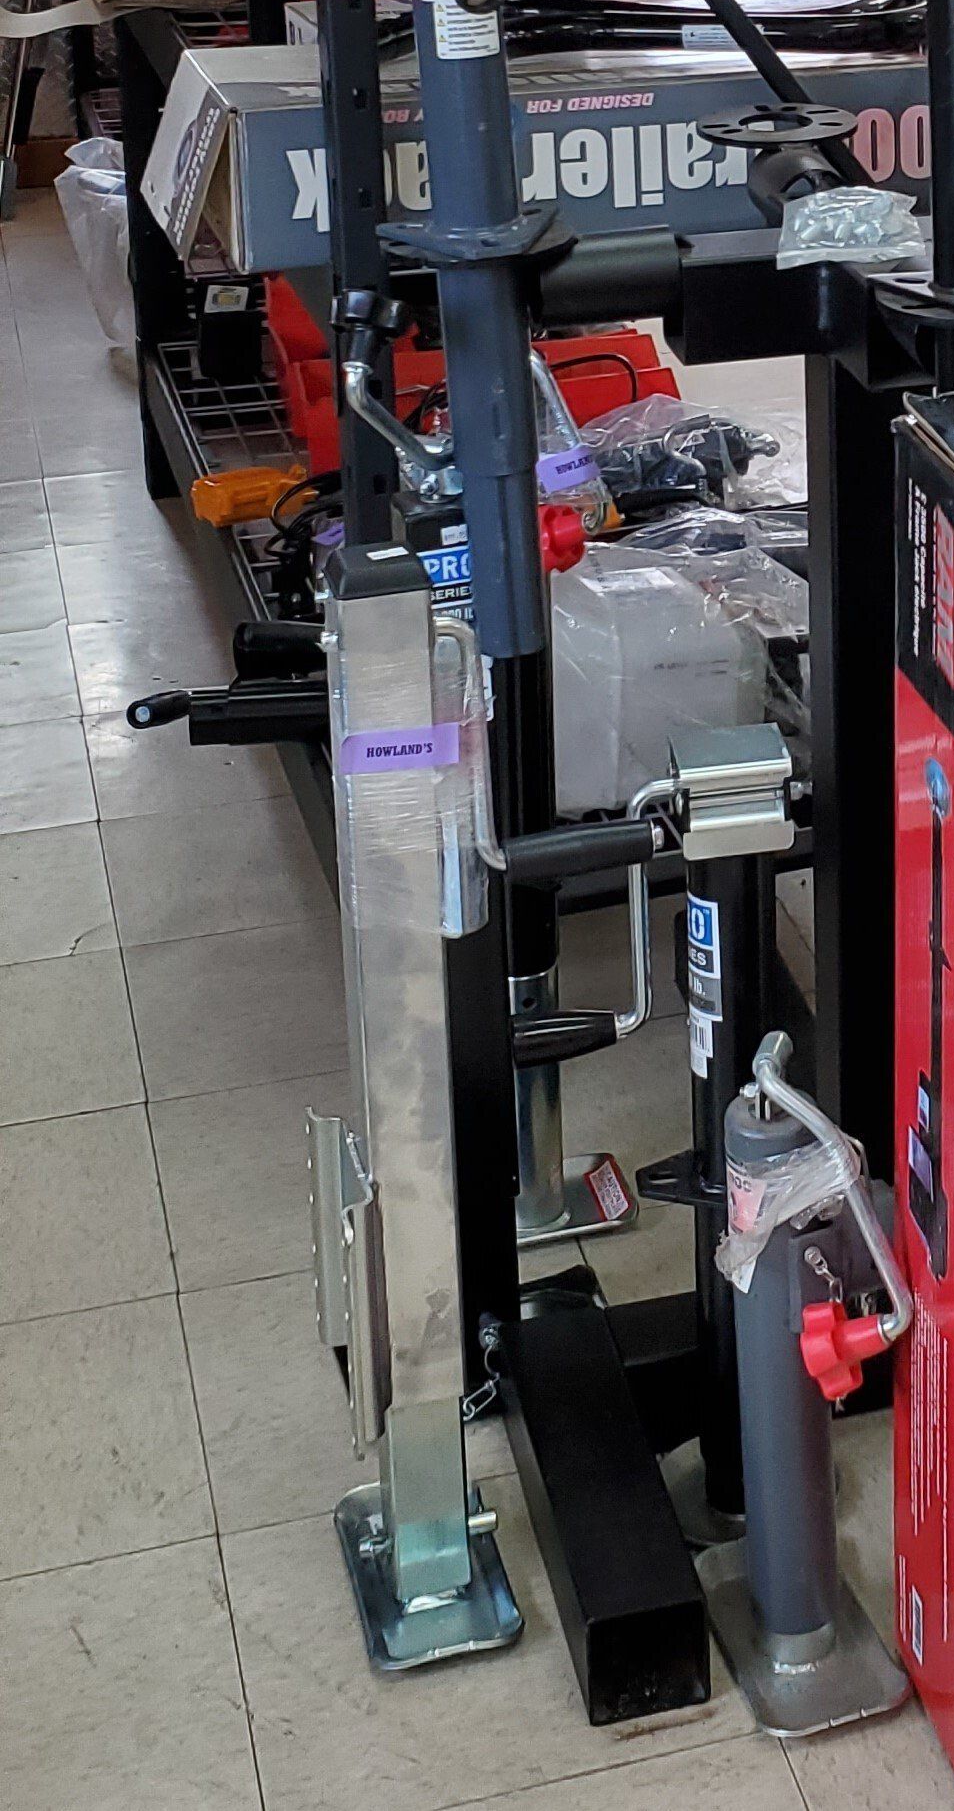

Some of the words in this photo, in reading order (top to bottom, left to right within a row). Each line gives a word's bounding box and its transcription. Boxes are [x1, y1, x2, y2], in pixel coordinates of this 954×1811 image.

[526, 97, 560, 114] FOR
[567, 93, 655, 112] DESIGNED
[522, 119, 775, 209] railer
[431, 586, 471, 601] SERIE
[366, 742, 433, 758] HOWLAND'S
